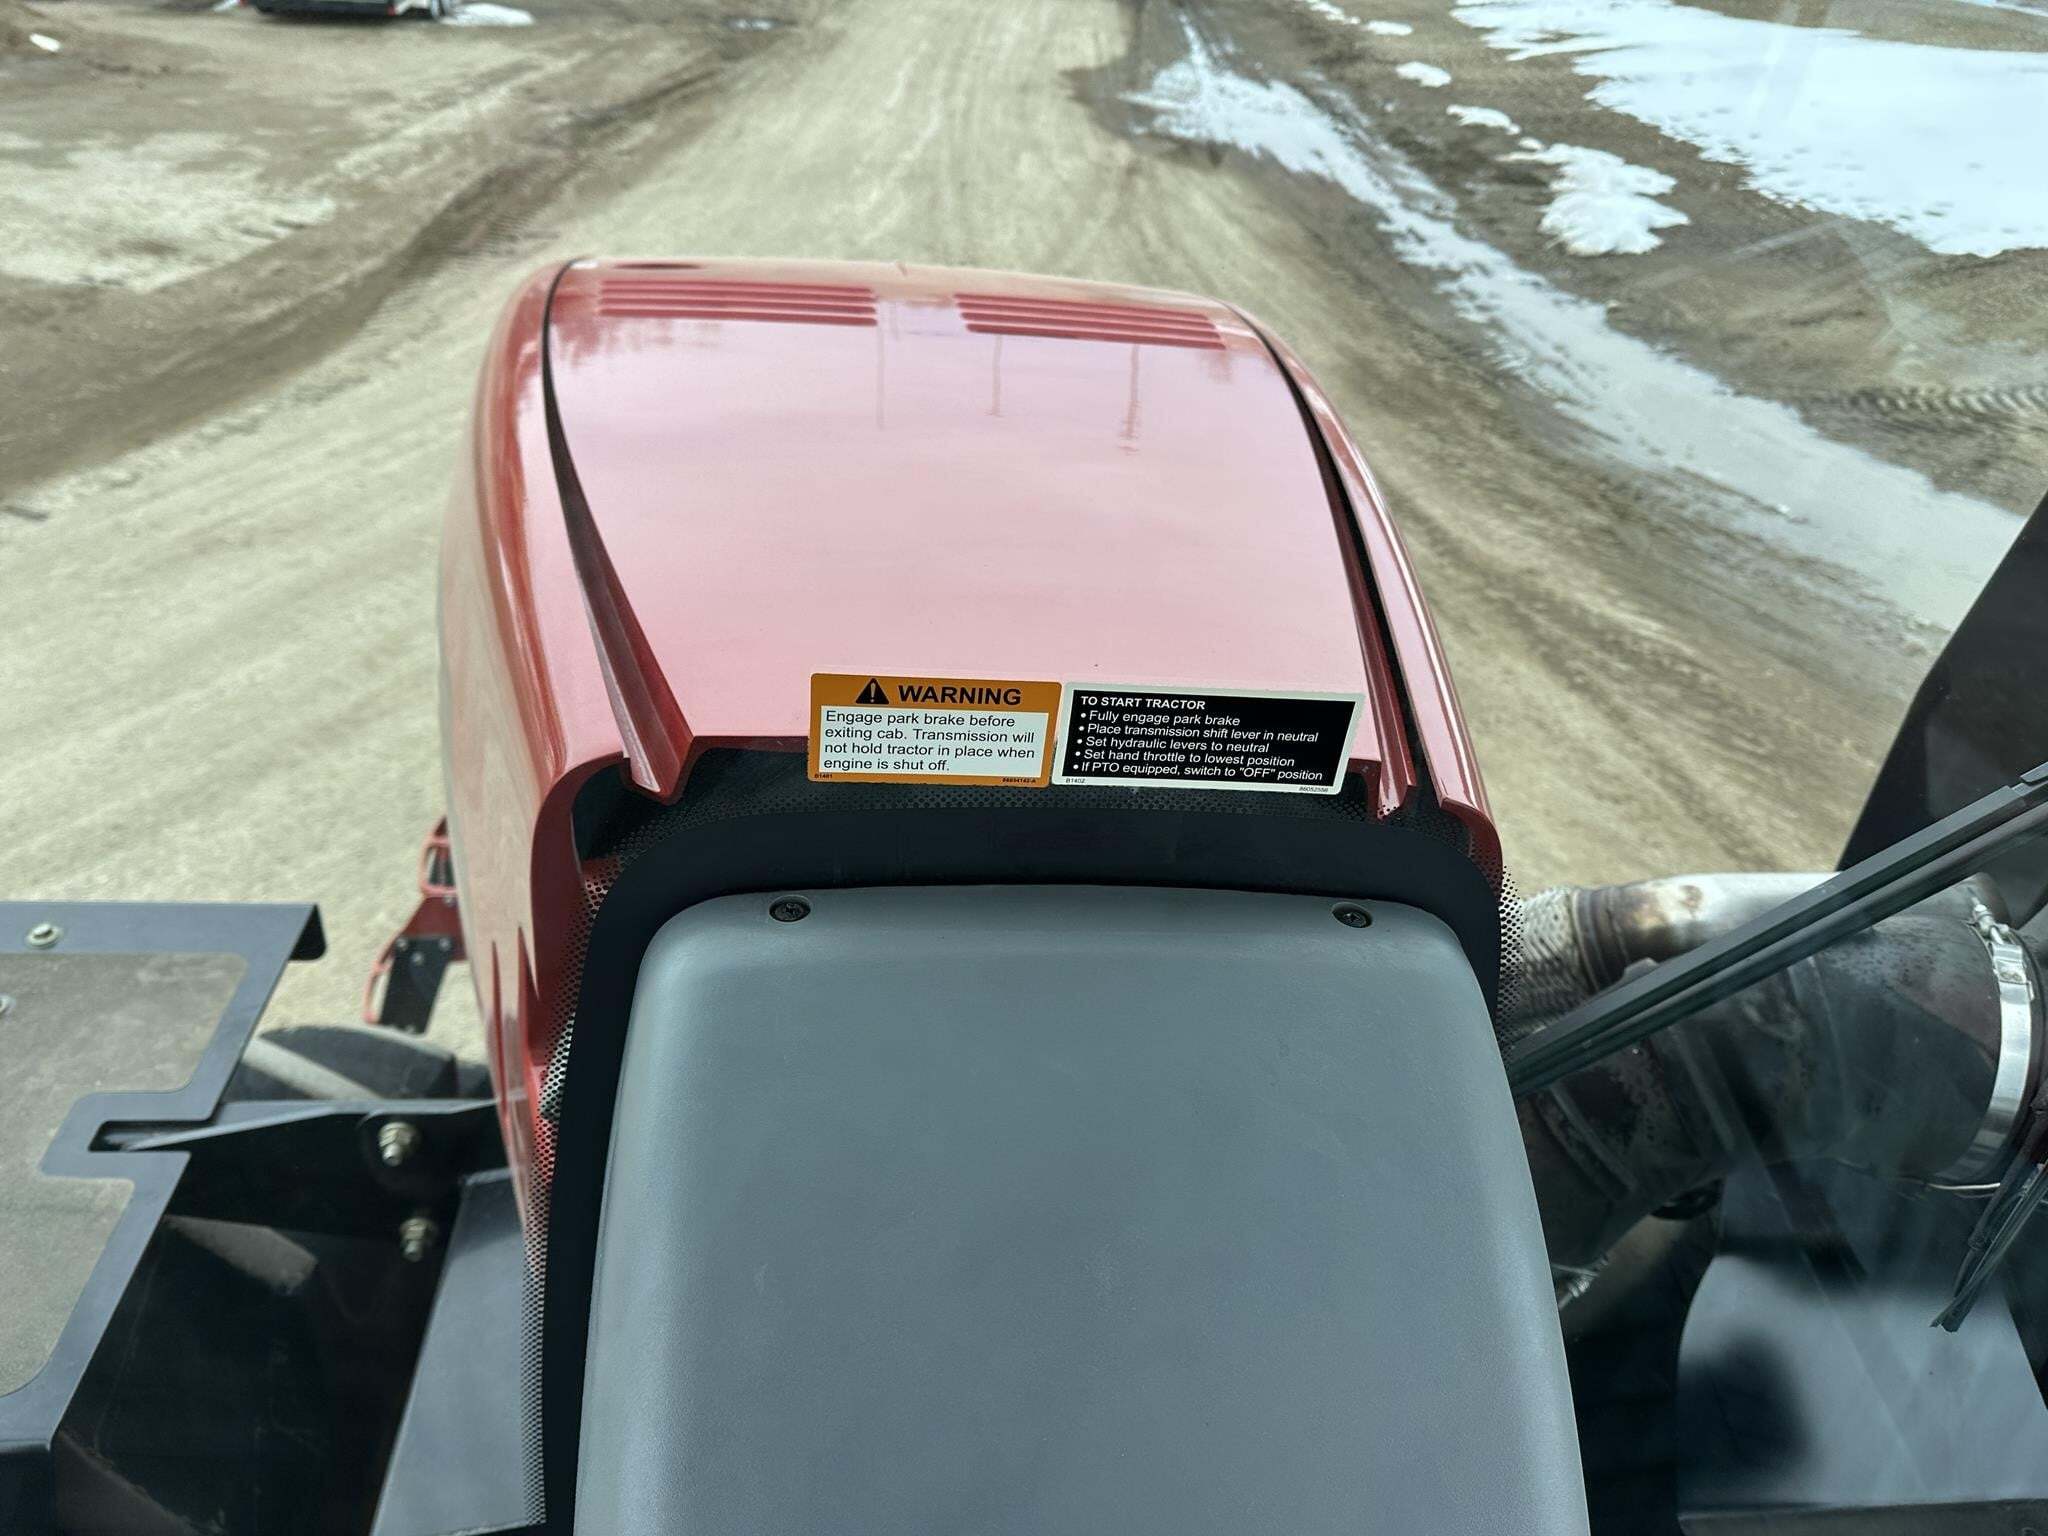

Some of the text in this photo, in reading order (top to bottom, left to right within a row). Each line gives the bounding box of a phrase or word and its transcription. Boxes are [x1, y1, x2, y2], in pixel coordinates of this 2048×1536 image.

[898, 685, 1021, 706] WARNING
[1081, 696, 1206, 710] TO START TRACTOR
[826, 710, 1015, 727] Engage park brake before
[1089, 710, 1241, 726] Fully engage park brake
[825, 728, 1035, 743] exiting cab. Transmission will
[1087, 723, 1319, 742] Place transmission shift lever in neutral
[824, 743, 1035, 759] not hold tractor in place when
[1085, 736, 1270, 753] Set hydraulic levers to neutral
[823, 758, 950, 771] engine is shut off.
[1083, 749, 1295, 767] Set hand throttle to lowest position
[1081, 761, 1323, 780] If PTO equipped, switch to "OFF" position
